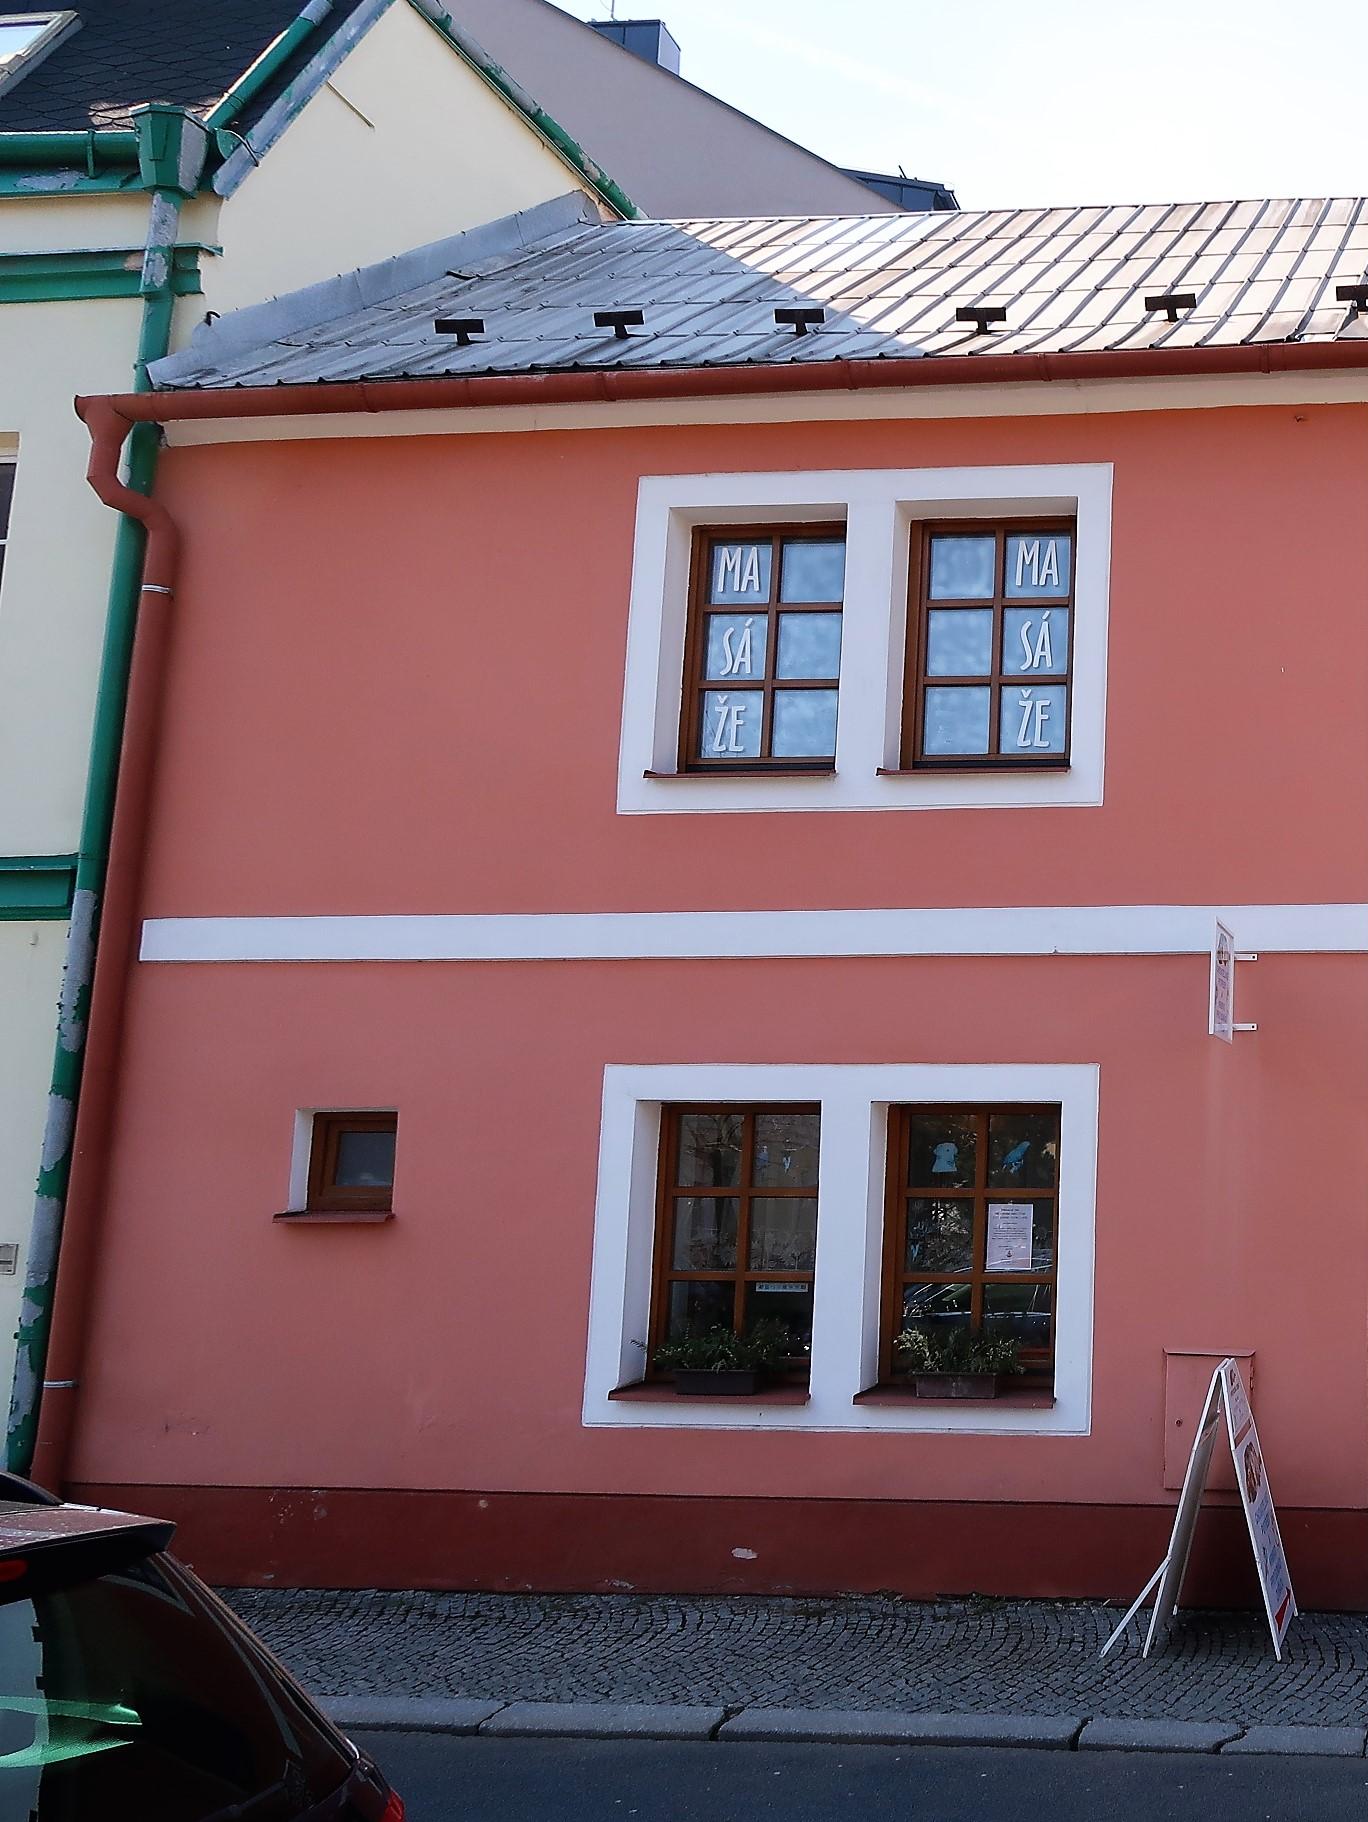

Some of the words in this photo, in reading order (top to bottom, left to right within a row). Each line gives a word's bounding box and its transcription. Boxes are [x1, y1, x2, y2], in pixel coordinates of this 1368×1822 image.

[717, 546, 760, 593] MA
[1015, 539, 1060, 587] MA
[719, 617, 753, 677] SÁ
[1020, 610, 1053, 671] SÁ
[711, 695, 746, 753] ŽE
[1016, 688, 1051, 749] ŽE
